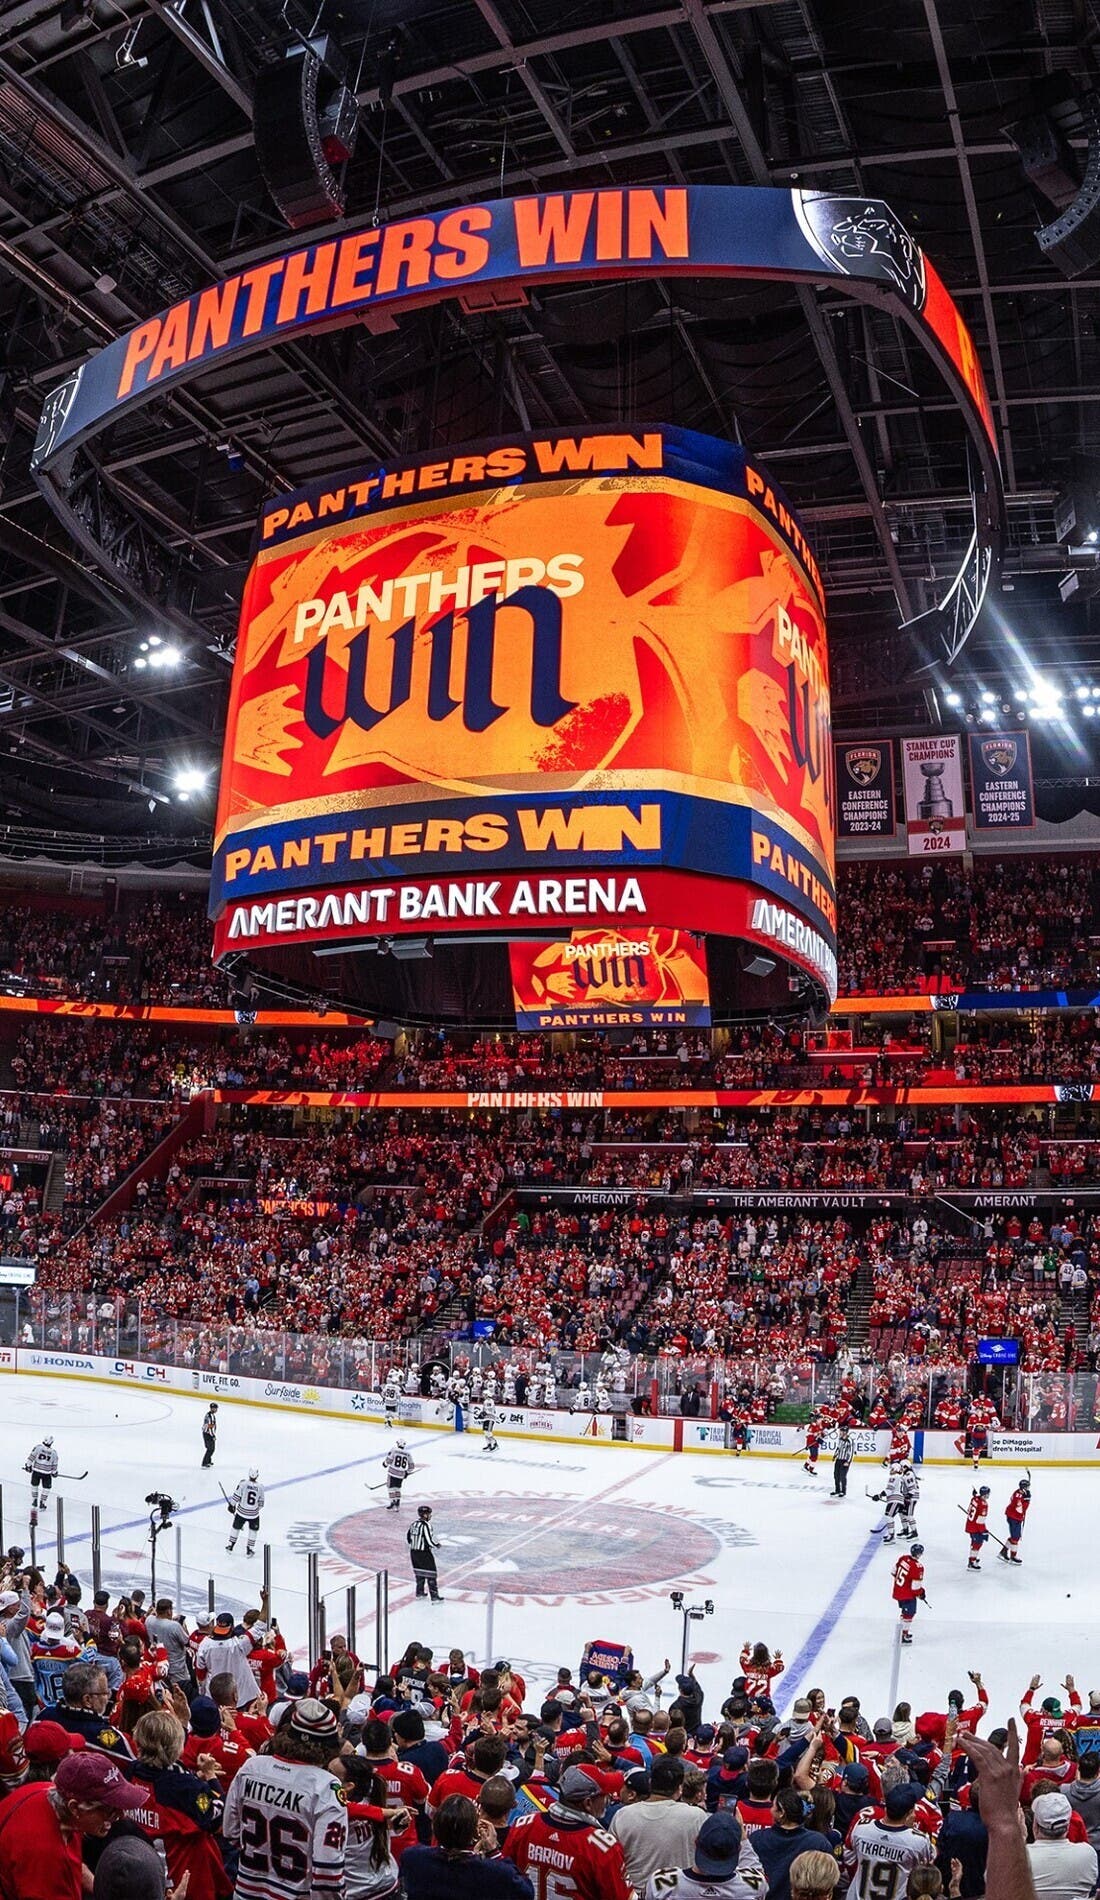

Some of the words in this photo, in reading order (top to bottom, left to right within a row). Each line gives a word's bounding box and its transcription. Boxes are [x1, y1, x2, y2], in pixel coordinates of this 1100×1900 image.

[116, 208, 492, 399] PANTHERS
[514, 189, 689, 267] WIN
[263, 448, 526, 539] PANTHERS
[532, 434, 663, 474] WIN
[304, 585, 578, 739] win
[906, 740, 940, 751] STANLEY
[940, 740, 956, 749] CUP
[909, 749, 955, 761] CHAMPIONS
[985, 781, 1019, 790] EASTERN
[848, 790, 881, 800] EASTERN
[979, 791, 1027, 801] CONFERENCE
[842, 800, 888, 811] CONFERENCE
[981, 801, 1026, 812] CHAMPIONS
[843, 811, 888, 821] CHAMPIONS
[988, 812, 1020, 822] 2024-25
[850, 821, 881, 831] 2023-24
[225, 809, 508, 882] PANTHERS
[517, 804, 661, 852] WIN
[923, 836, 951, 850] 2024
[228, 887, 395, 939] AMERANT
[399, 881, 503, 919] BANK
[508, 878, 646, 915] ARENA
[565, 941, 650, 958] PANTHERS
[572, 955, 648, 989] win
[540, 1013, 643, 1026] PANTHERS
[651, 1013, 686, 1022] WIN
[467, 1092, 563, 1107] PANTHERS
[566, 1092, 603, 1107] WIN
[574, 1194, 630, 1204] AMERANT
[733, 1196, 754, 1207] THE
[758, 1196, 819, 1207] AMERANT
[823, 1196, 866, 1207] VAULT
[974, 1195, 1037, 1207] AMERANT
[44, 1358, 94, 1370] HONDA
[115, 1361, 134, 1373] CH
[147, 1366, 166, 1379] CH
[202, 1374, 218, 1384] LIVE.
[264, 1383, 301, 1398] Surfside
[584, 1397, 589, 1407] 8
[755, 1436, 783, 1446] FINANCIAL
[756, 1430, 782, 1439] TROPICAL
[821, 1428, 876, 1441] COCAST
[820, 1441, 877, 1452] BUESS
[394, 1455, 408, 1469] 86
[247, 1491, 257, 1506] 6
[222, 1741, 239, 1755] 16
[244, 1778, 305, 1813] WITCZAK
[241, 1804, 311, 1884] 26
[587, 1828, 617, 1853] 16
[528, 1842, 575, 1871] BARKOV
[861, 1841, 905, 1861] TKACHUK
[860, 1858, 899, 1900] 19
